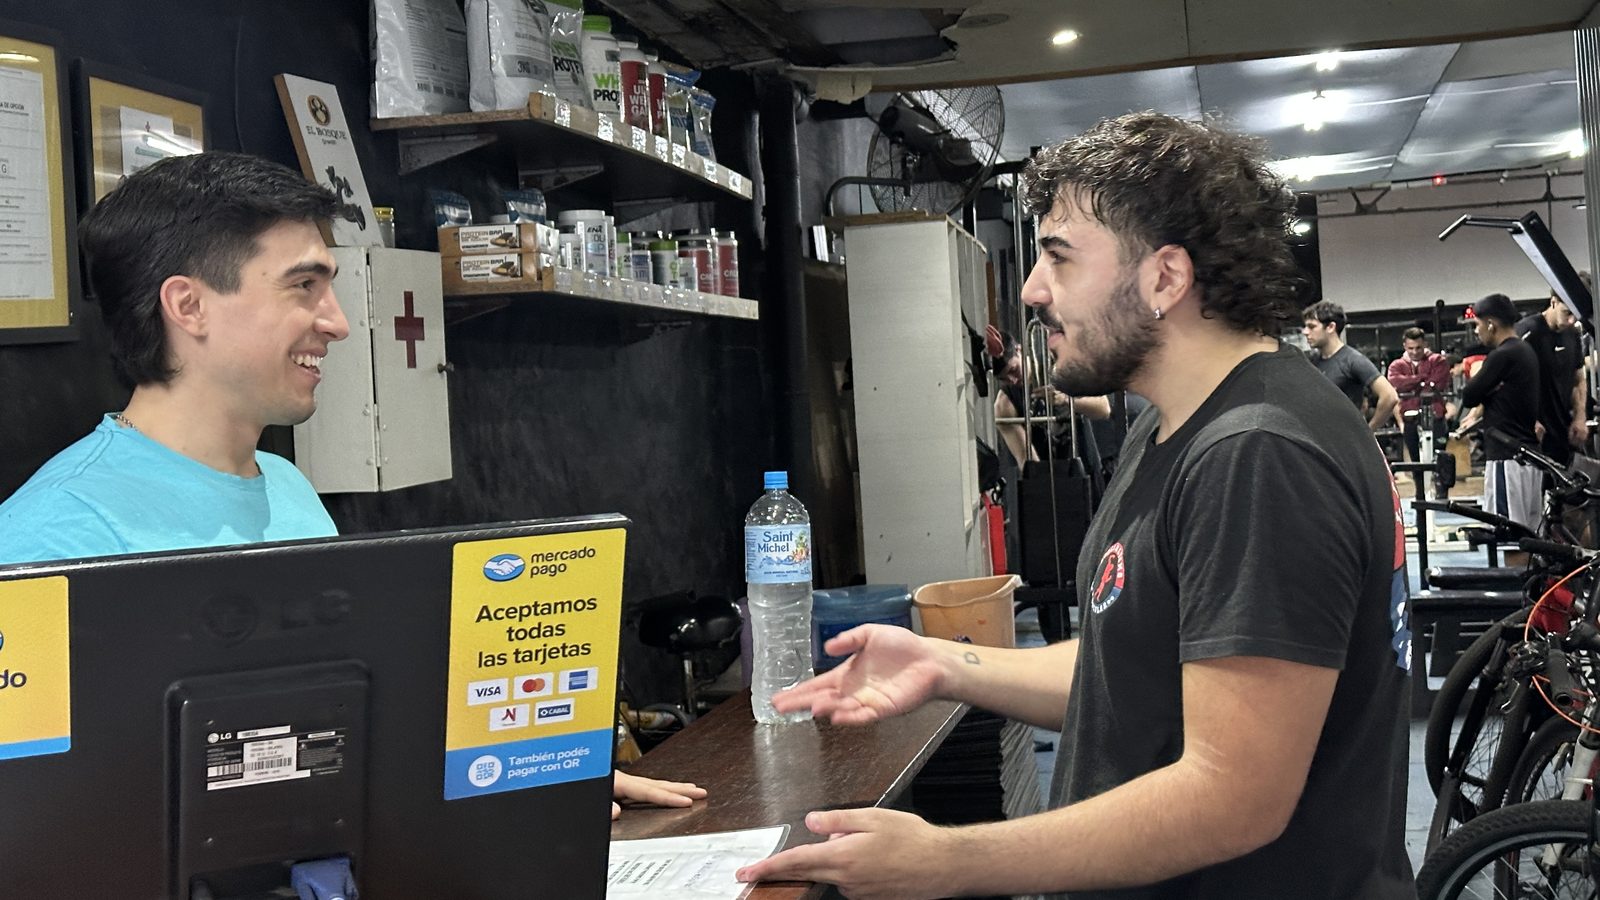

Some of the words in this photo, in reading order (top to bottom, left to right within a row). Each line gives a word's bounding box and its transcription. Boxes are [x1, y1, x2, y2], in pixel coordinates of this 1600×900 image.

[592, 73, 620, 89] WH
[593, 88, 620, 101] PRO
[315, 127, 347, 140] BOSQUE
[763, 531, 794, 542] Saint
[531, 546, 596, 564] mercado
[758, 543, 790, 553] Michel
[530, 563, 567, 579] pago
[475, 598, 597, 623] Aceptamos
[506, 622, 566, 642] todas
[478, 651, 508, 668] las
[513, 643, 592, 665] tarjetas
[476, 686, 501, 697] VISA
[220, 732, 232, 741] LG
[508, 751, 555, 766] También
[557, 746, 591, 761] podés
[507, 765, 539, 780] pagar
[541, 763, 561, 772] con
[563, 758, 581, 769] QR
